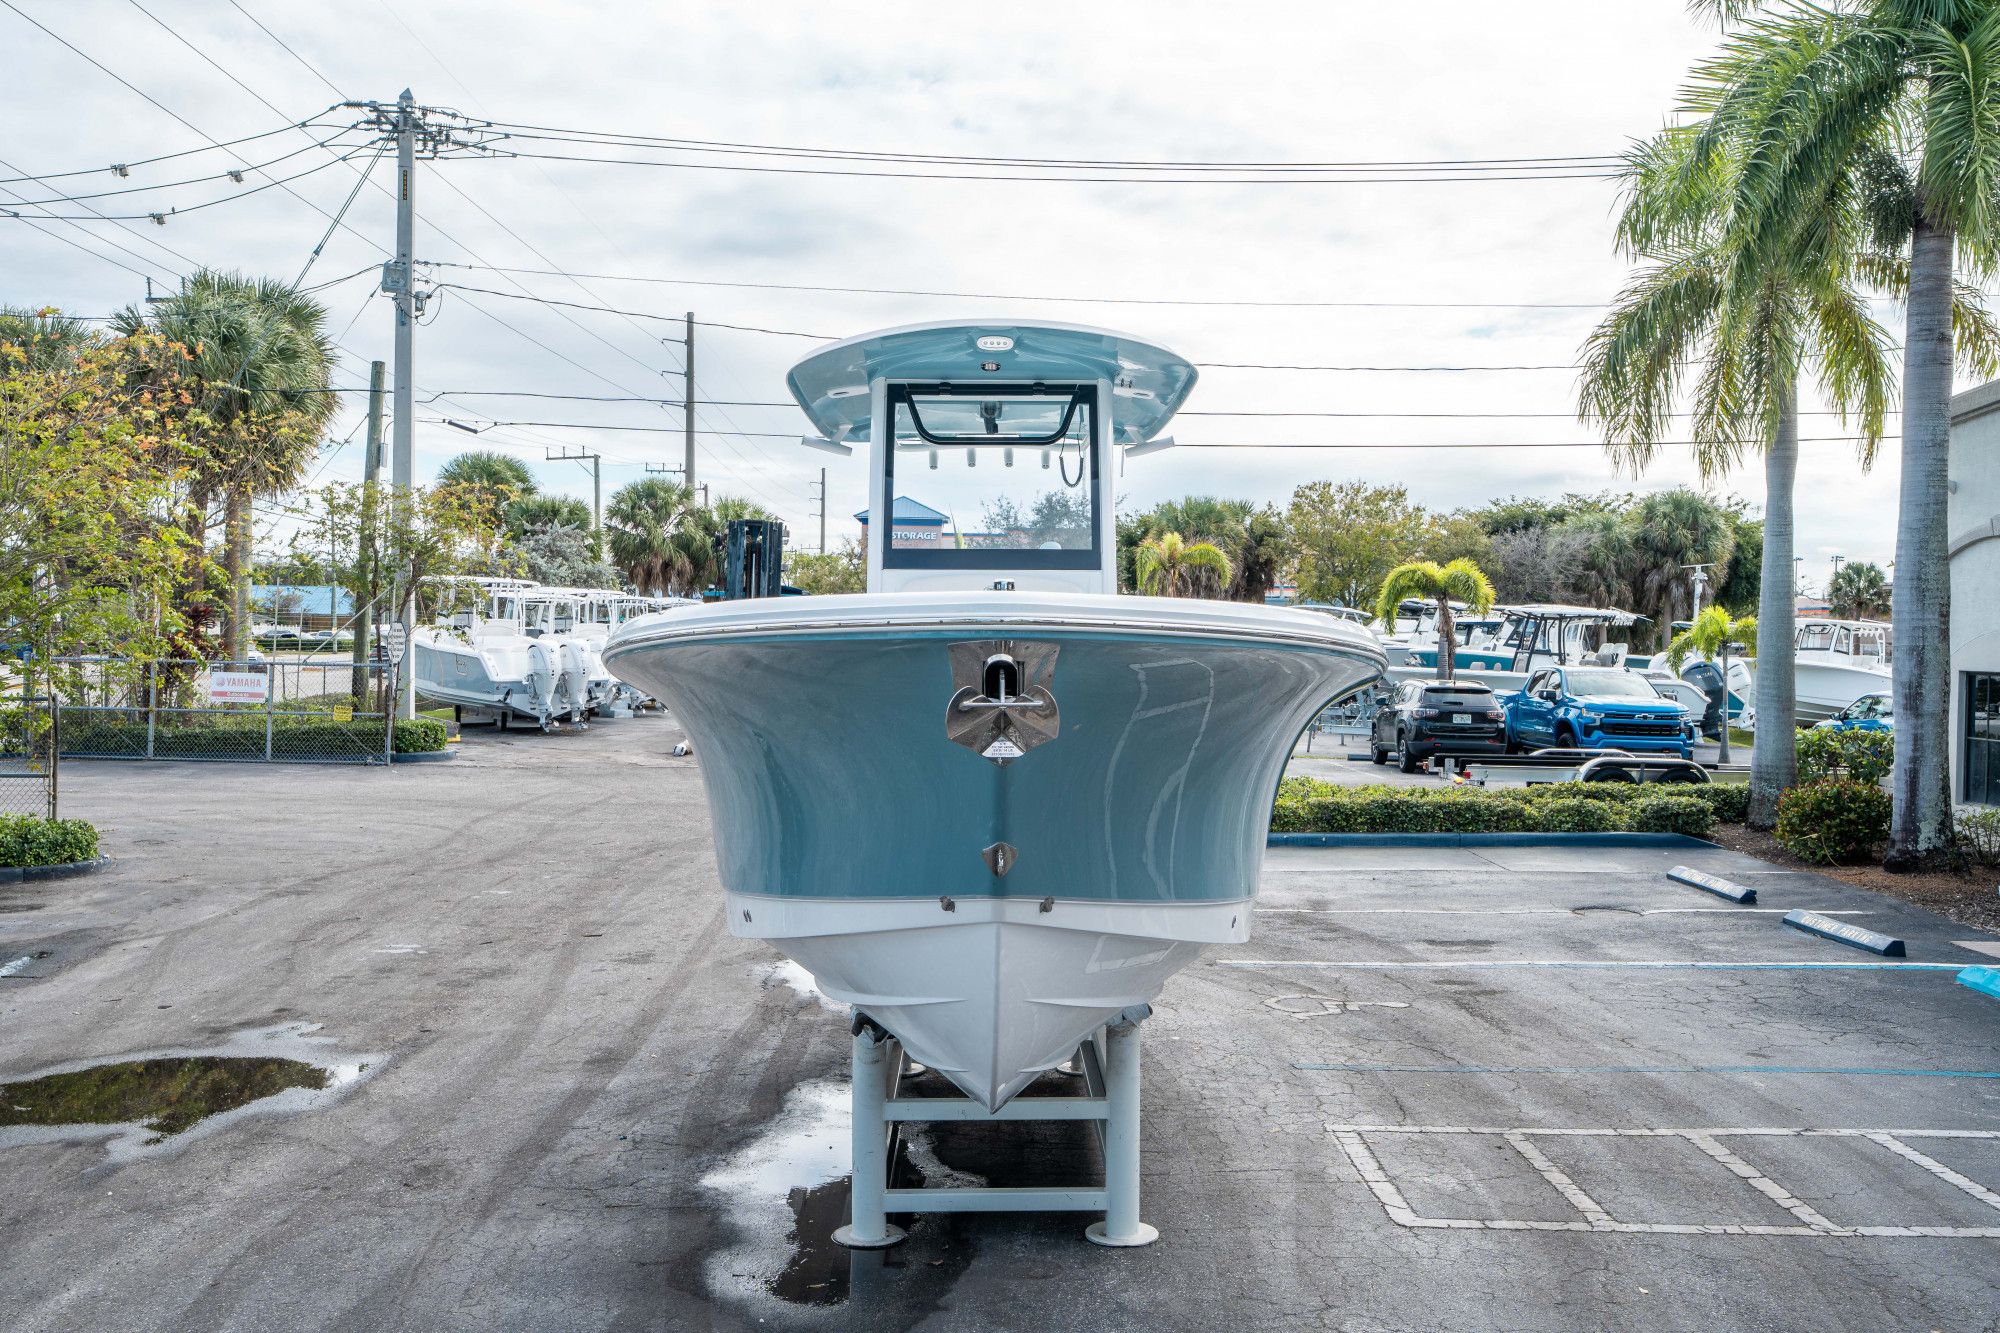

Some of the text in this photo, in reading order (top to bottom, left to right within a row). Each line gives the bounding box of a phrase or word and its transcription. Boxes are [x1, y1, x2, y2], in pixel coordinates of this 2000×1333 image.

[892, 532, 937, 540] STORAGE
[226, 678, 262, 689] YAMAHA
[1801, 915, 1873, 943] CUSTOMER PARKING
